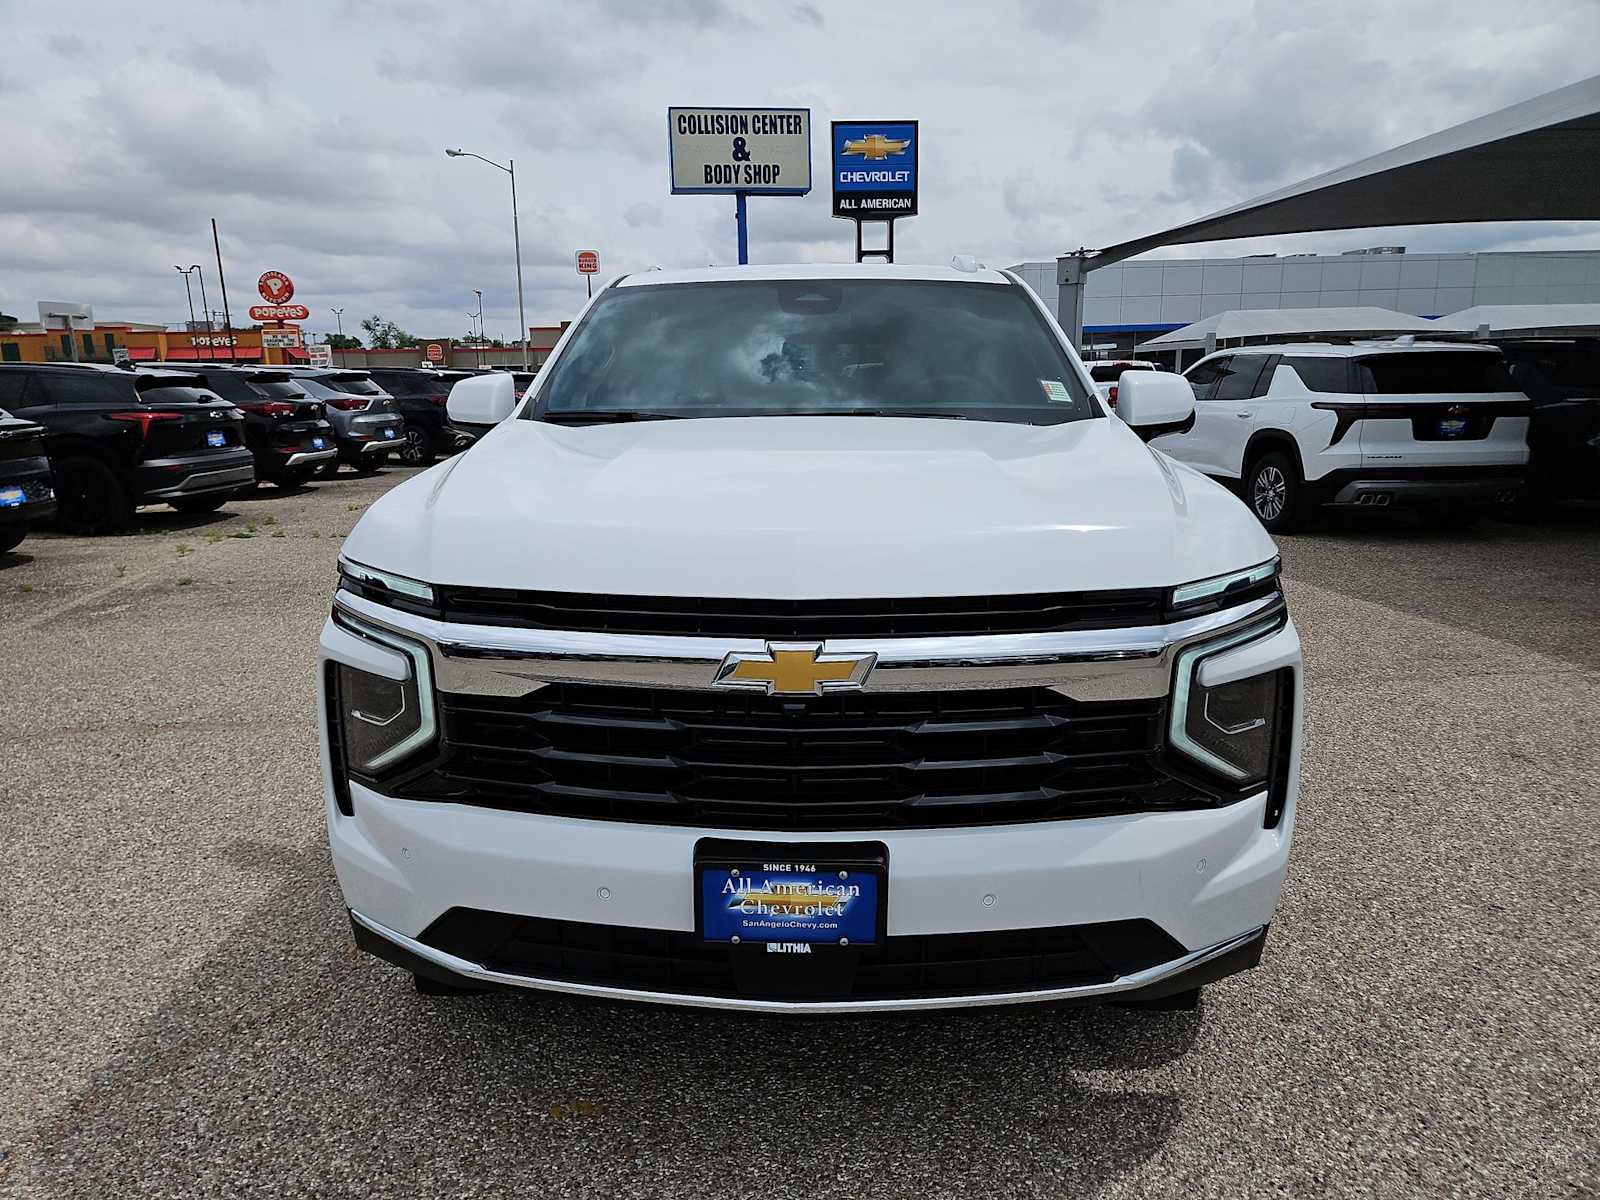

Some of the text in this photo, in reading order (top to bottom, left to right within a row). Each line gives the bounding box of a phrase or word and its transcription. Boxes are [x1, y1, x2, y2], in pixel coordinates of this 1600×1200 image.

[678, 114, 802, 135] COLLISION CENTER
[732, 136, 750, 162] &
[704, 164, 780, 184] BODY SHOP
[839, 171, 910, 183] CHEVROLET
[839, 198, 912, 209] ALL AMERICAN
[763, 863, 816, 873] SINCE 1946
[721, 877, 861, 897] All American
[740, 899, 843, 917] Chevrolet
[742, 919, 838, 930] SanAngeloChevy.com
[777, 942, 812, 953] LITHIA
